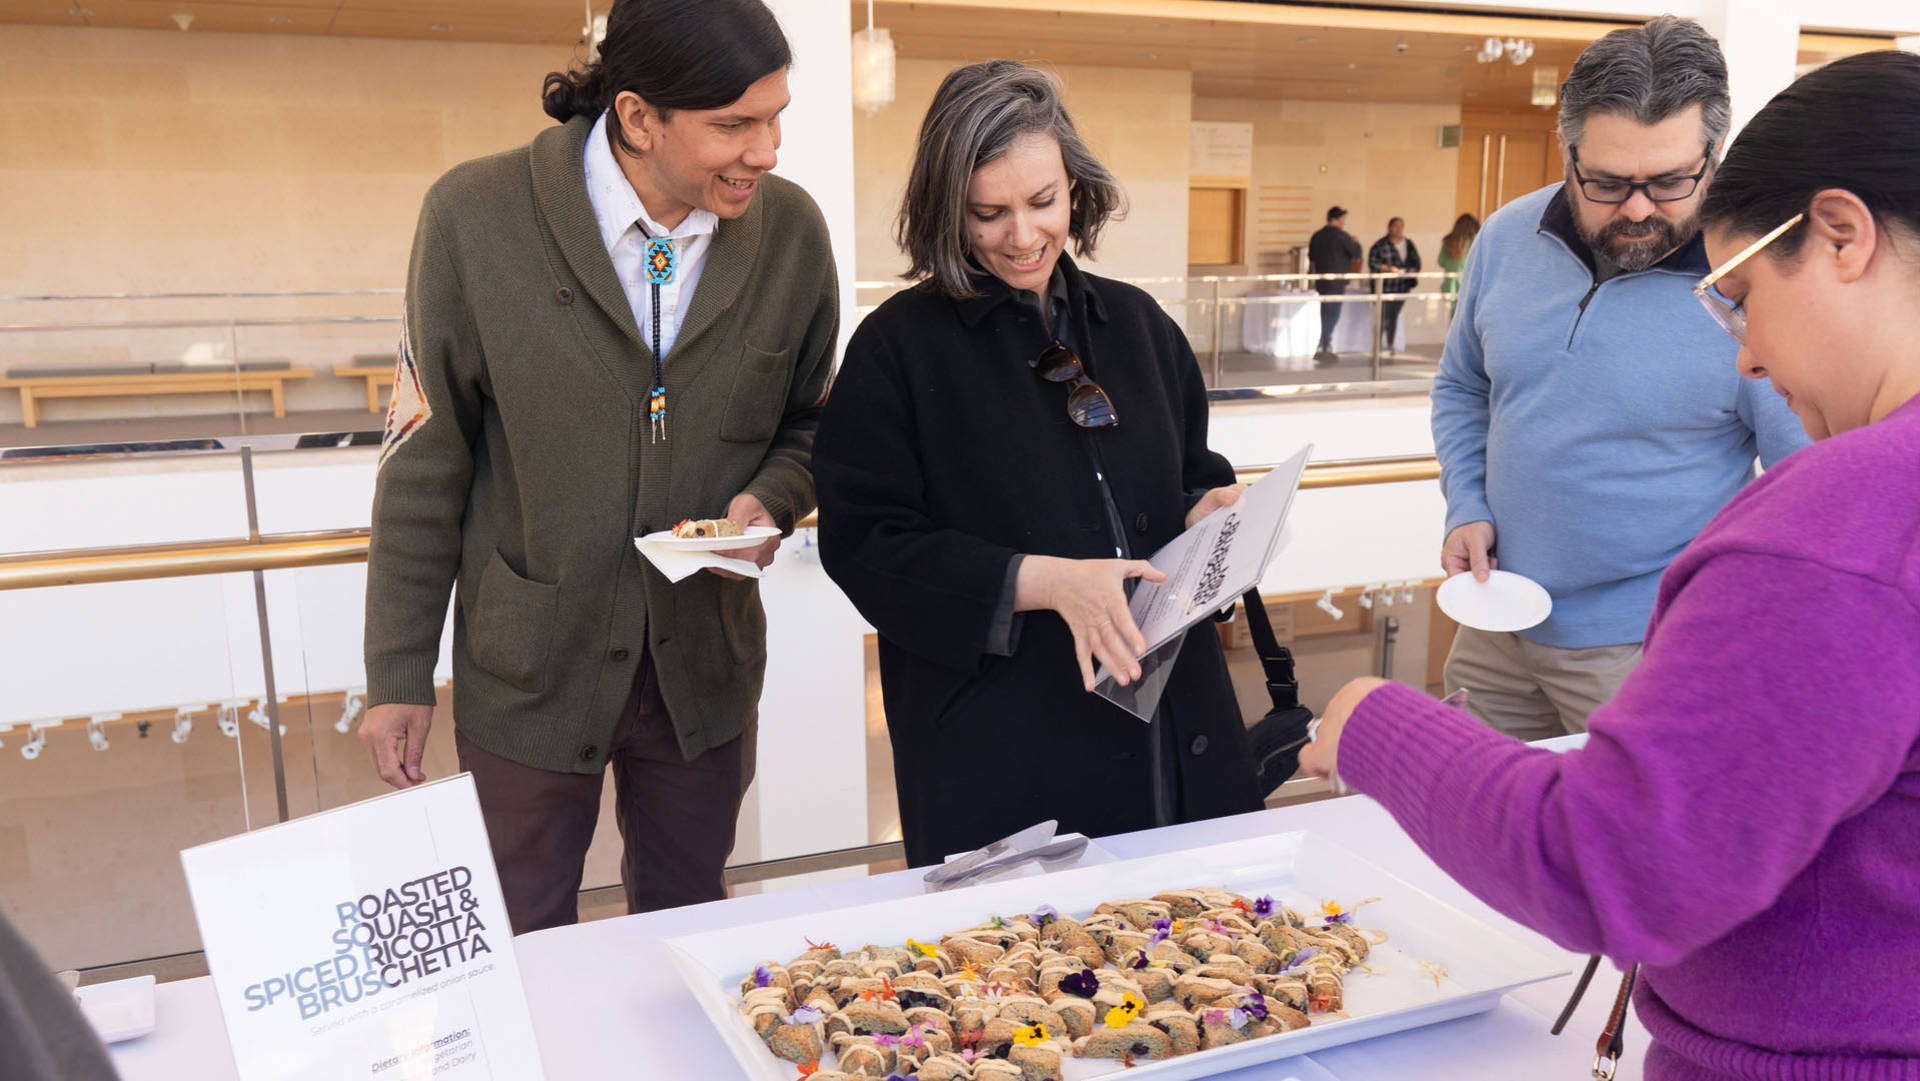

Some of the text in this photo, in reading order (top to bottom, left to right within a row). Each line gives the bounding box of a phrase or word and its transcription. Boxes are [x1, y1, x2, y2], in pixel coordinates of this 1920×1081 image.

[332, 888, 479, 955] SQUASH &
[336, 866, 472, 927] ROASTED
[244, 911, 486, 1012] SPICED RICOTTA
[297, 933, 491, 1020] BRUSCHETTA
[309, 1016, 345, 1036] Served
[347, 1008, 369, 1023] with
